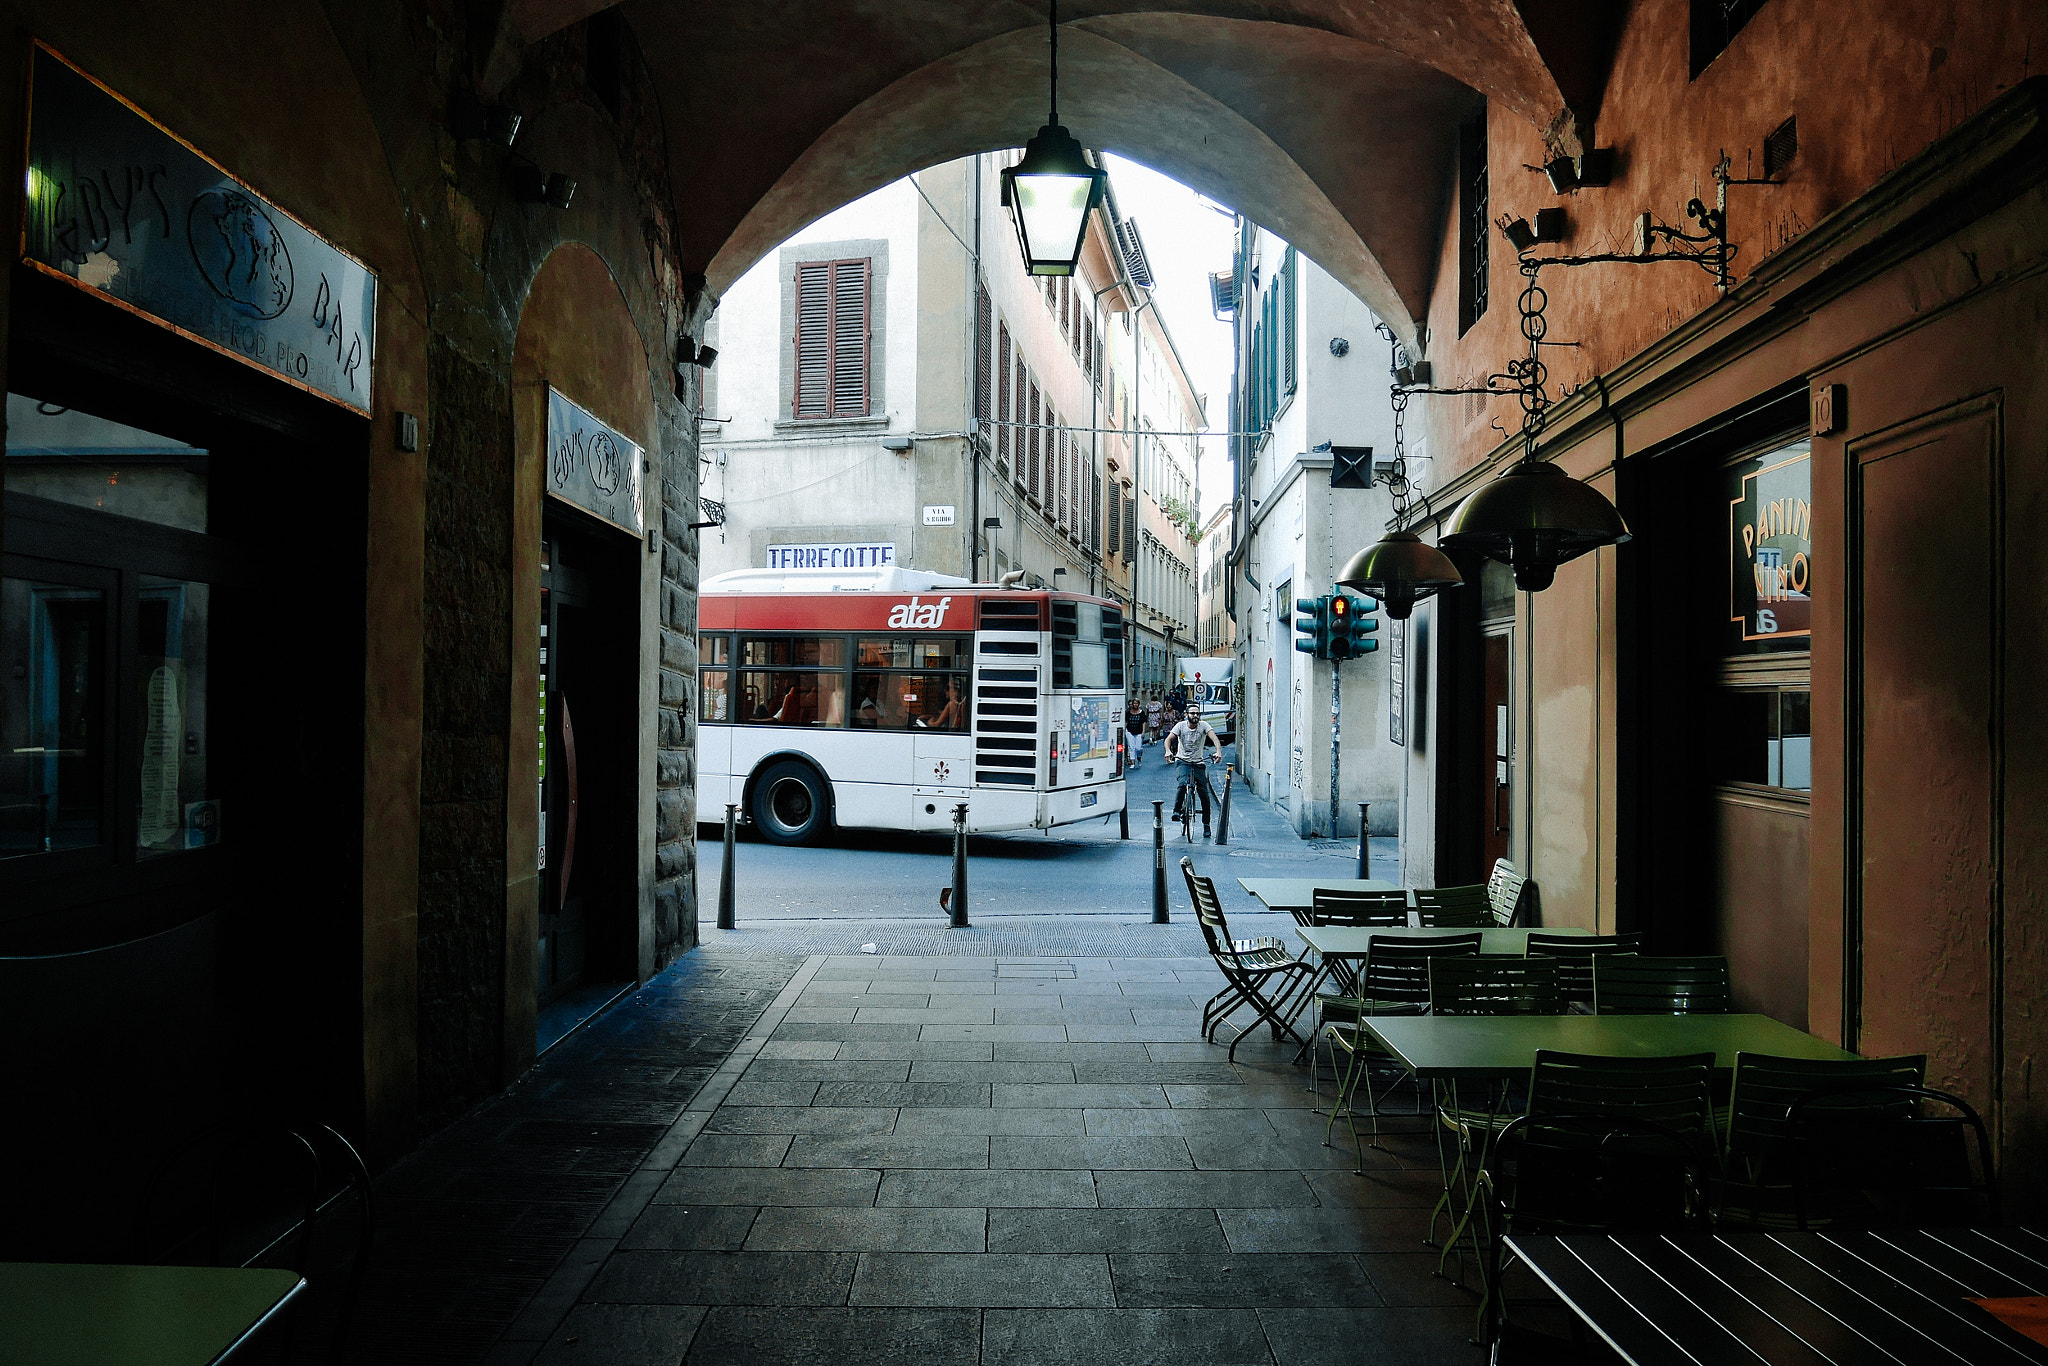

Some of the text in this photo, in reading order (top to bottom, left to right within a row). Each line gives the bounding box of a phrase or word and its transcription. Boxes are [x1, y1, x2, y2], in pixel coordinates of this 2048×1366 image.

[312, 273, 362, 391] BAR
[1815, 397, 1830, 425] 10
[1742, 498, 1811, 559] PANIN
[768, 546, 893, 569] TERRECOTTE
[1754, 552, 1808, 604] VINO
[888, 596, 951, 629] ataf
